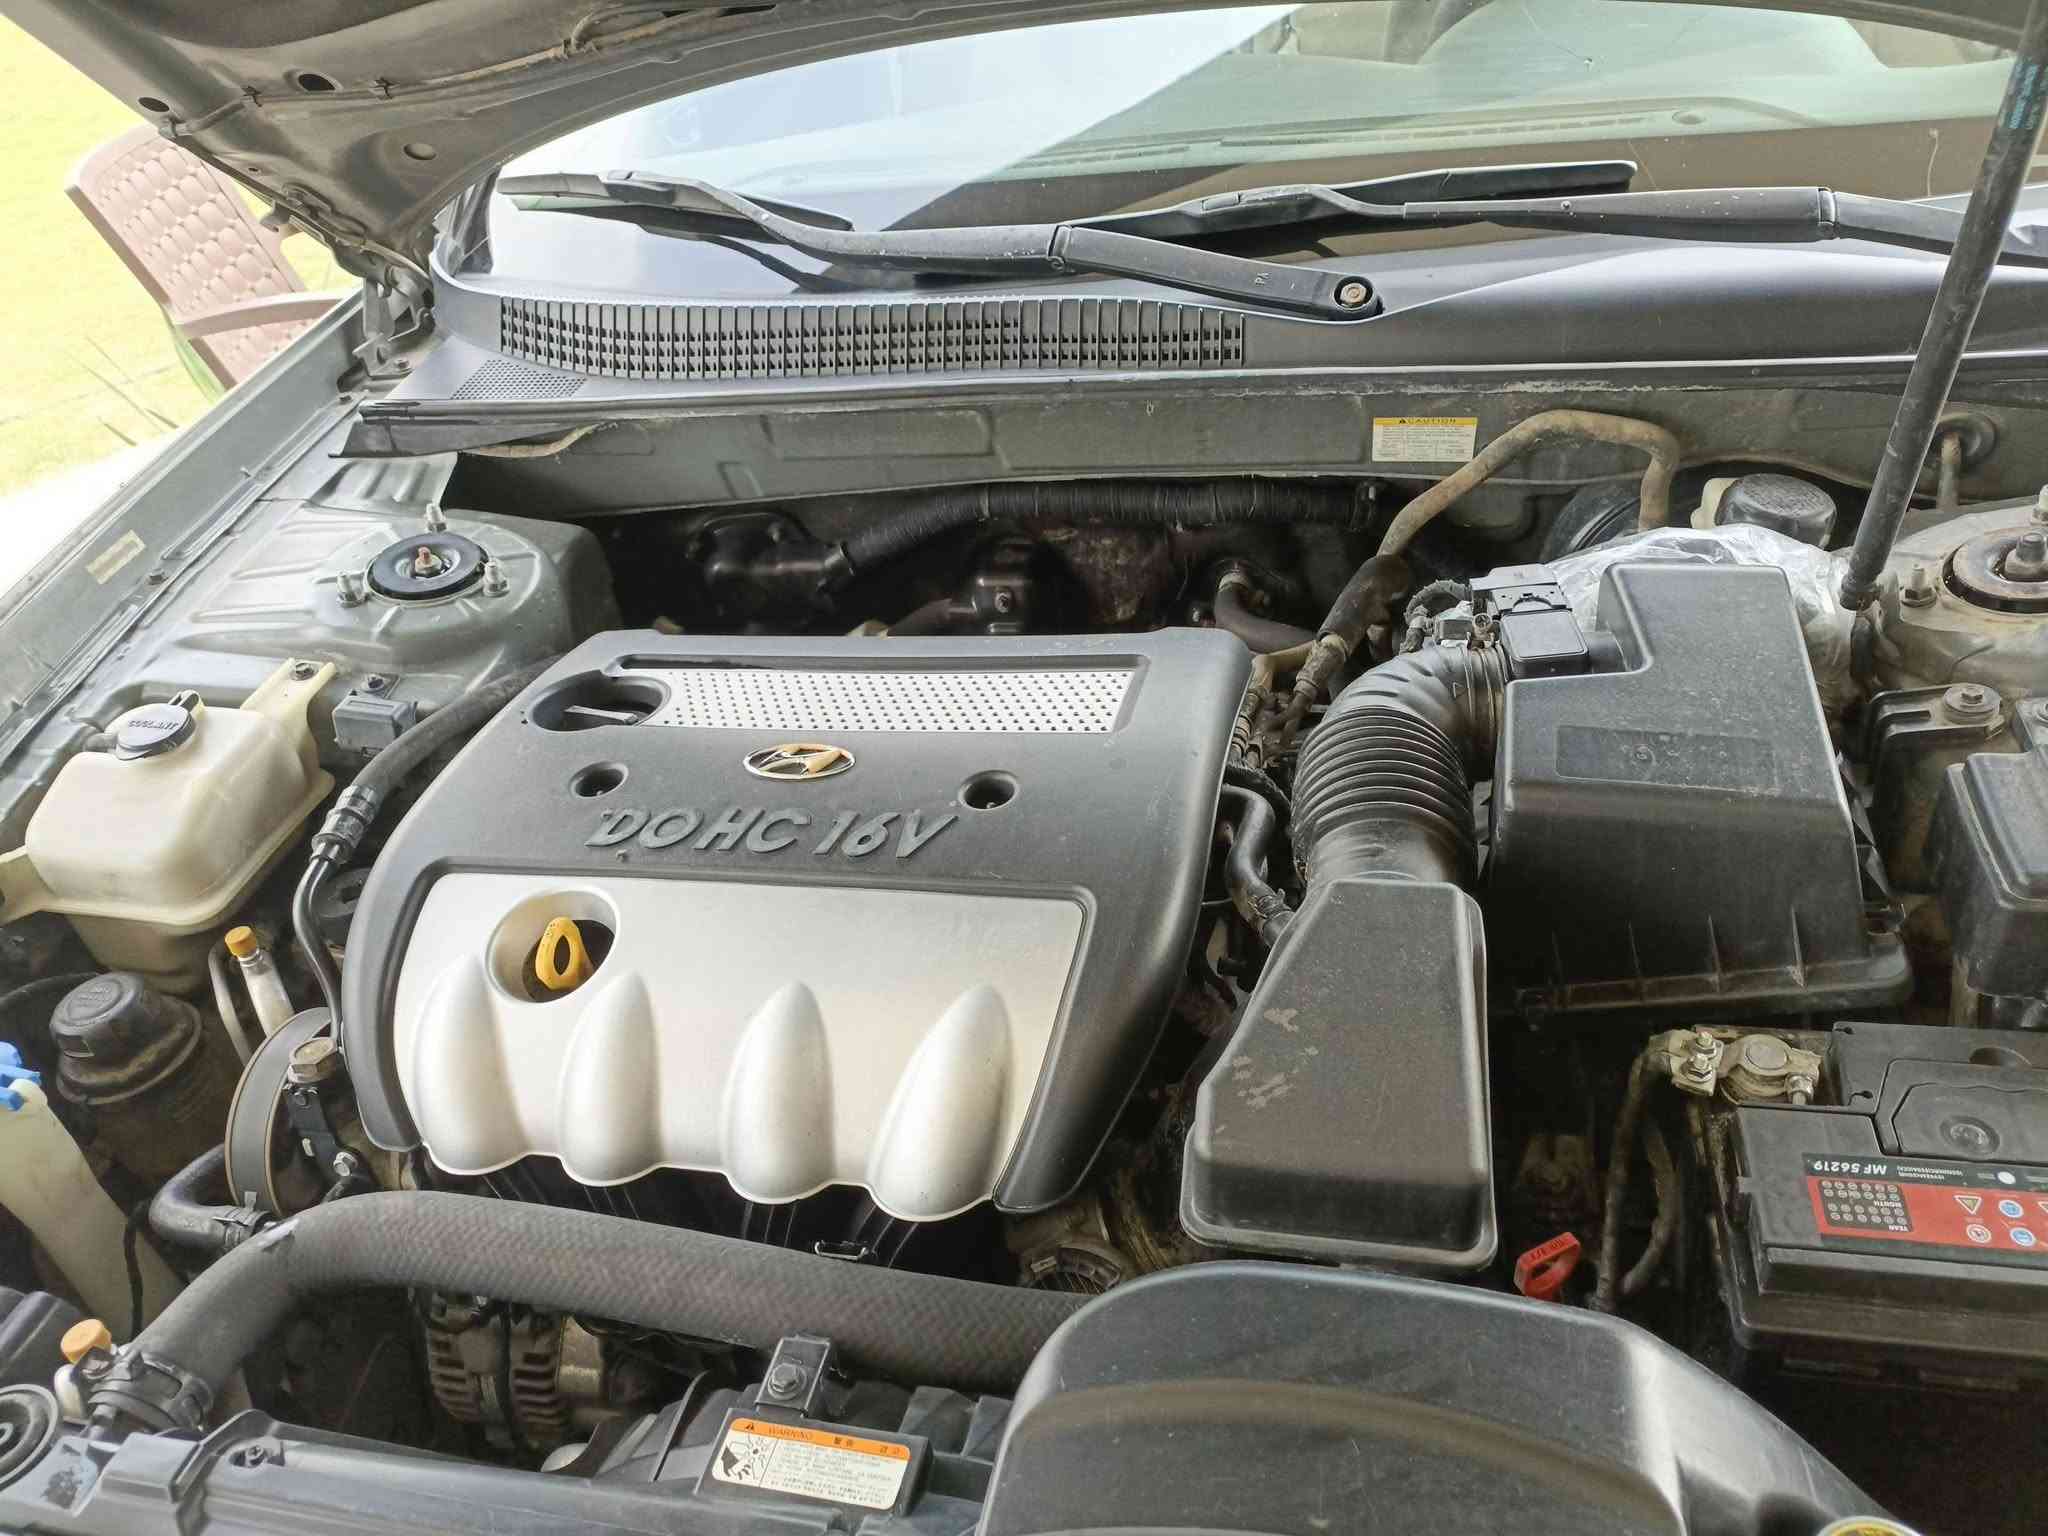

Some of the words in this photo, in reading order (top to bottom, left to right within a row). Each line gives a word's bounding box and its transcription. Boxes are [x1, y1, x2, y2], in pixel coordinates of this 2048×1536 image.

[584, 807, 814, 855] DOHC
[811, 809, 959, 859] 16V
[1813, 1160, 1861, 1175] 56219
[1863, 1164, 1888, 1176] MF
